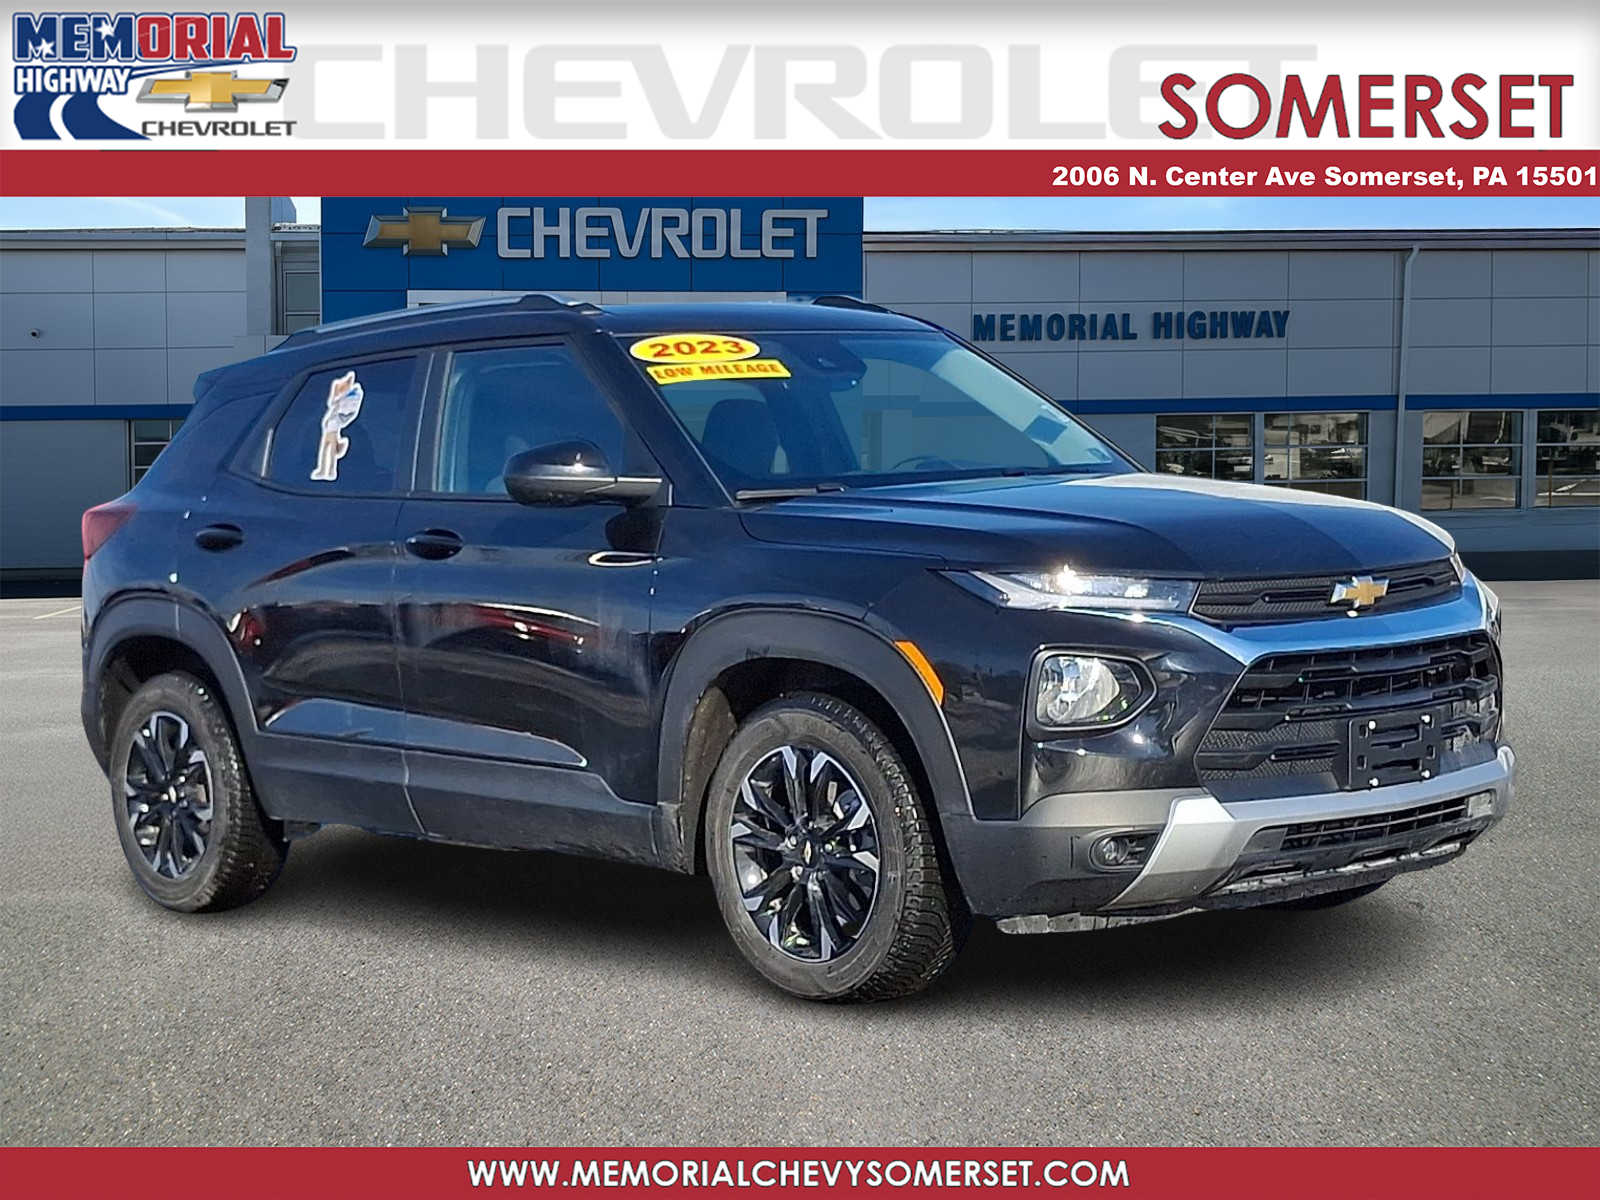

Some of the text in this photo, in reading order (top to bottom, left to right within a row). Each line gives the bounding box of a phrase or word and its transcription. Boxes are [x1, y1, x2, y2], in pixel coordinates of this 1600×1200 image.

[497, 207, 829, 258] CHEVROLET
[973, 310, 1290, 341] MEMORIAL HIGHWAY
[649, 340, 745, 357] 2023
[653, 363, 780, 379] LOW MILEAGE
